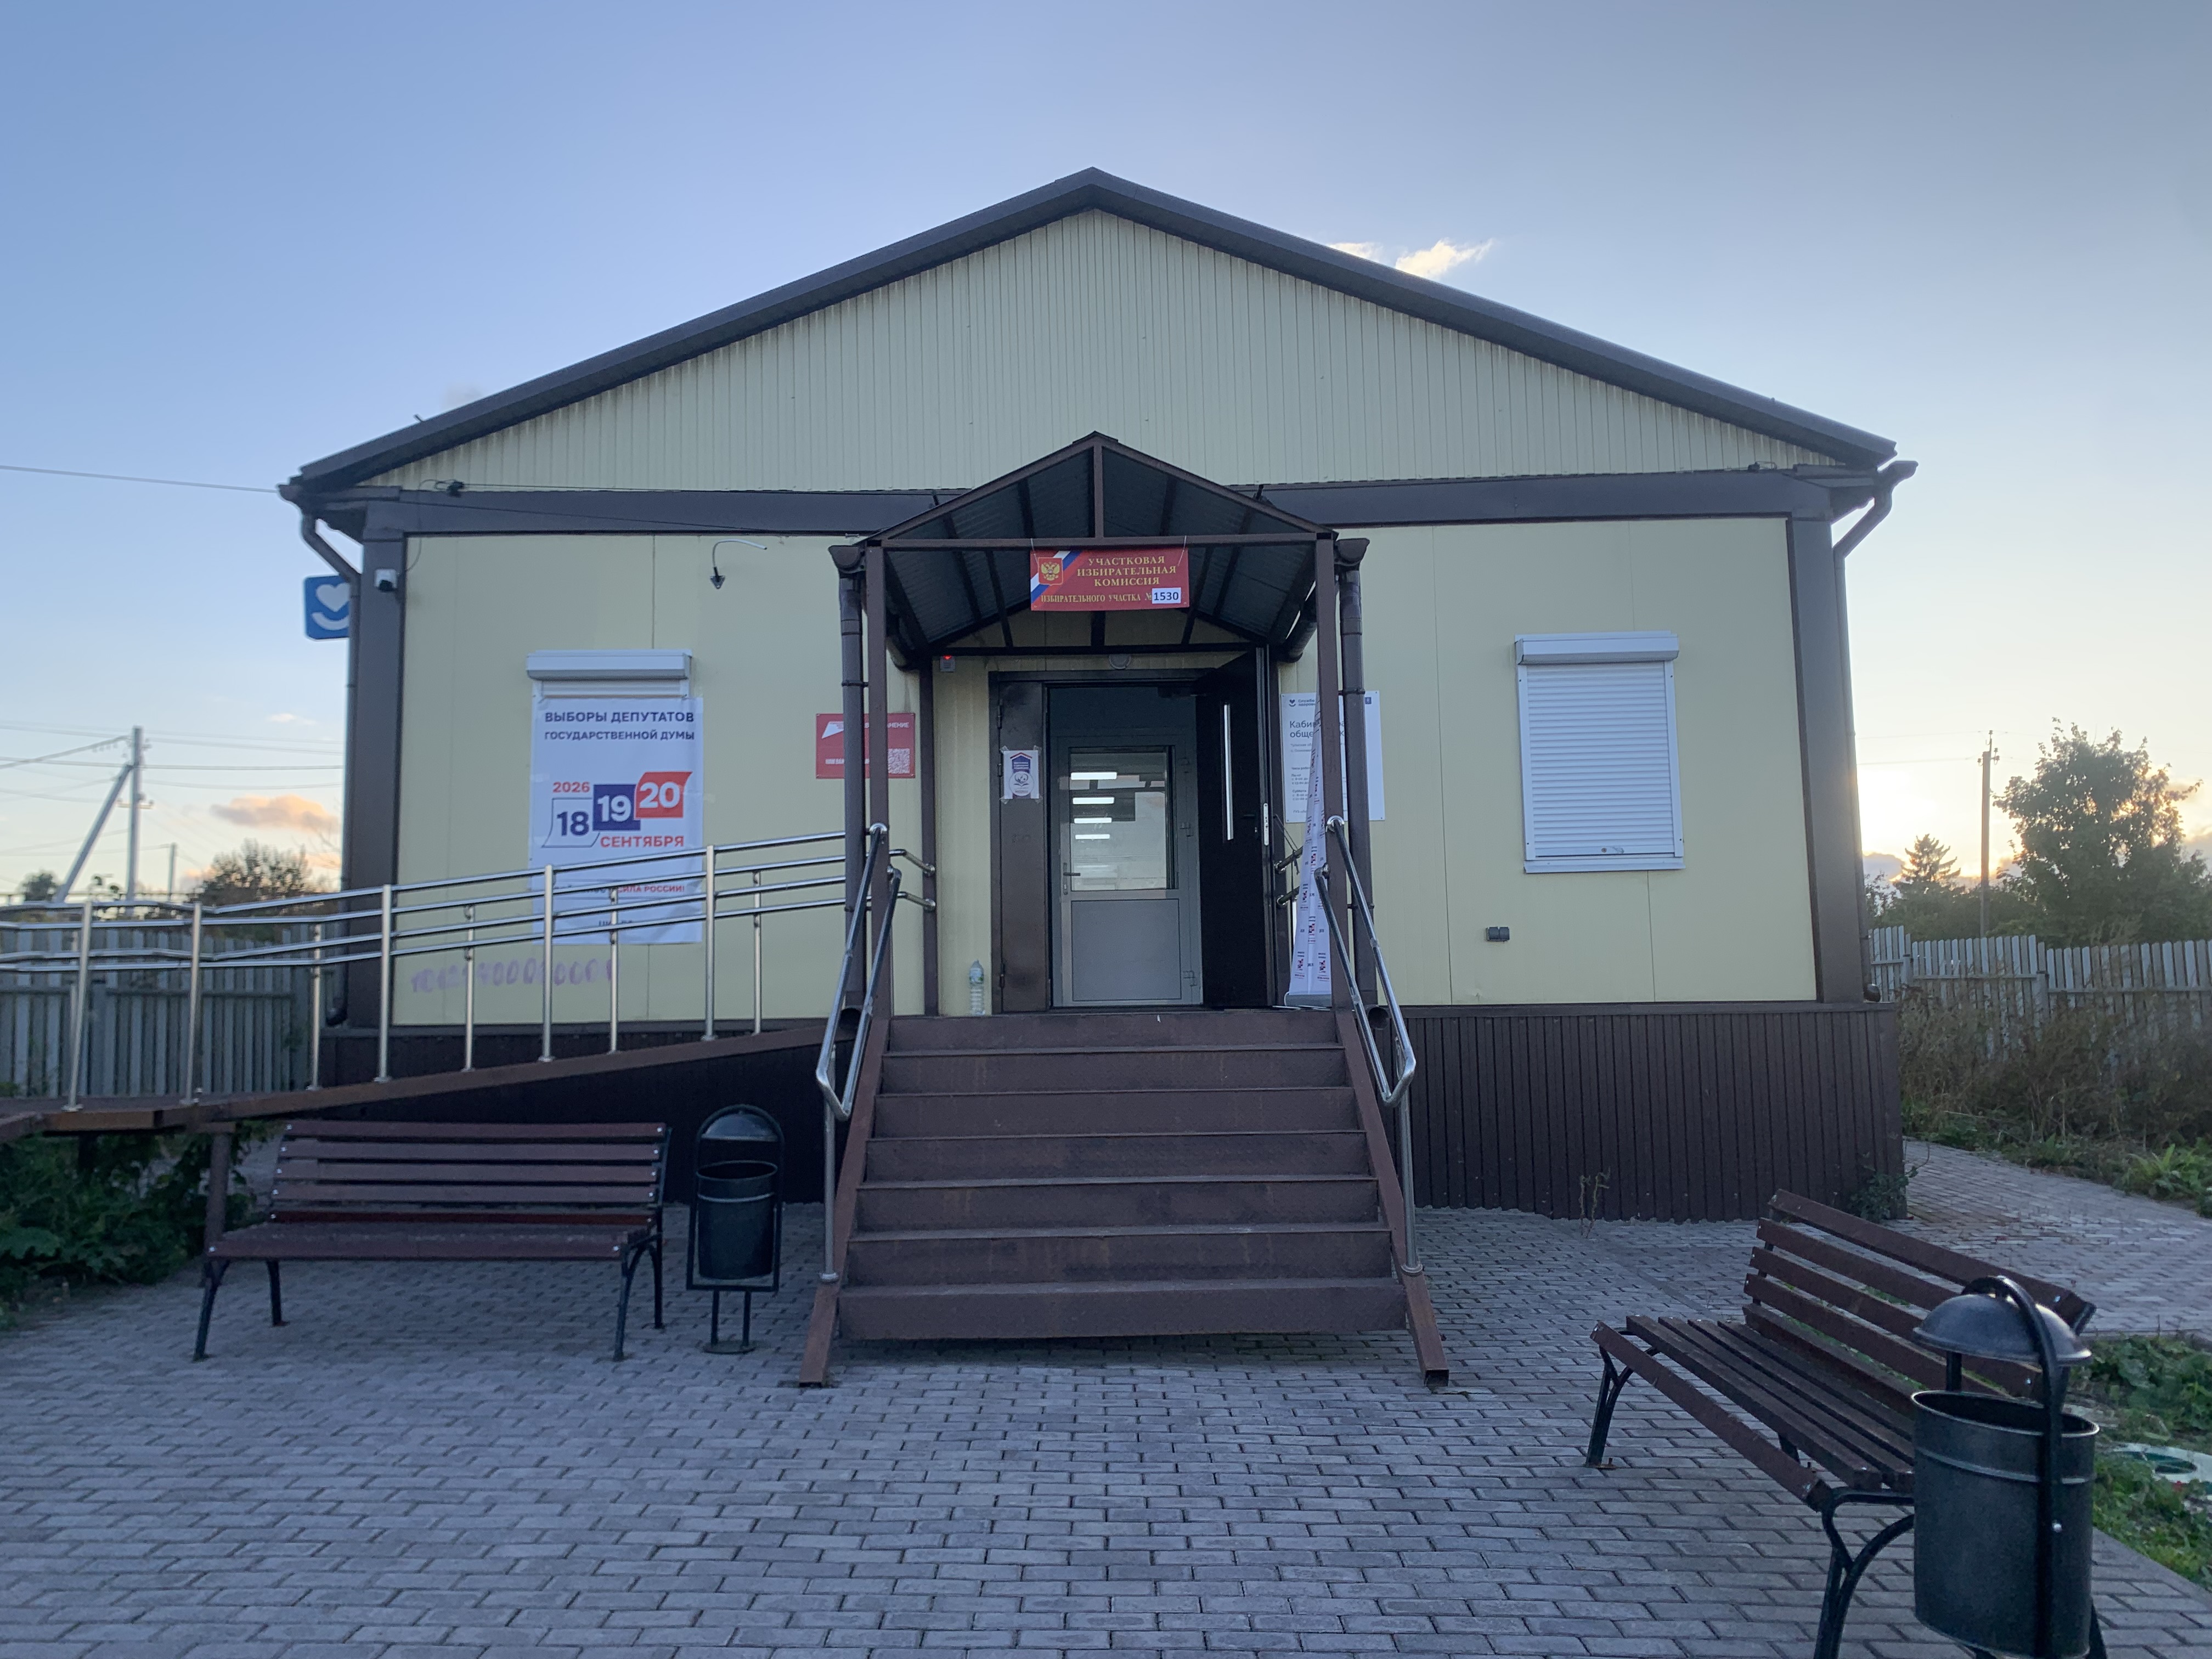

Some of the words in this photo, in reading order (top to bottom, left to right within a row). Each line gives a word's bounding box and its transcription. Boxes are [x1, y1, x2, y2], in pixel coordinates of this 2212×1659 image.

[1088, 555, 1165, 566] УЧАСТКОВАЯ
[1076, 565, 1177, 577] ИЗБИРАТЕЛЬНАЯ
[1094, 577, 1160, 587] КОМИССИЯ
[1041, 594, 1105, 603] ИЗБИРАТЕЛЬНОГО
[1108, 594, 1141, 602] УЧАСТКА
[1153, 591, 1179, 601] 1530
[545, 712, 607, 723] ВЫБОРЫ
[611, 712, 694, 724] ДЕПУТАТОВ
[544, 730, 657, 741] ГОСУДАРСТВЕННОЙ
[660, 731, 695, 741] ДУМЫ
[552, 782, 590, 793] 2026
[556, 811, 590, 837] 18
[597, 794, 632, 822] 19
[639, 781, 681, 809] 20
[600, 836, 684, 848] СЕНТЯБРЯ
